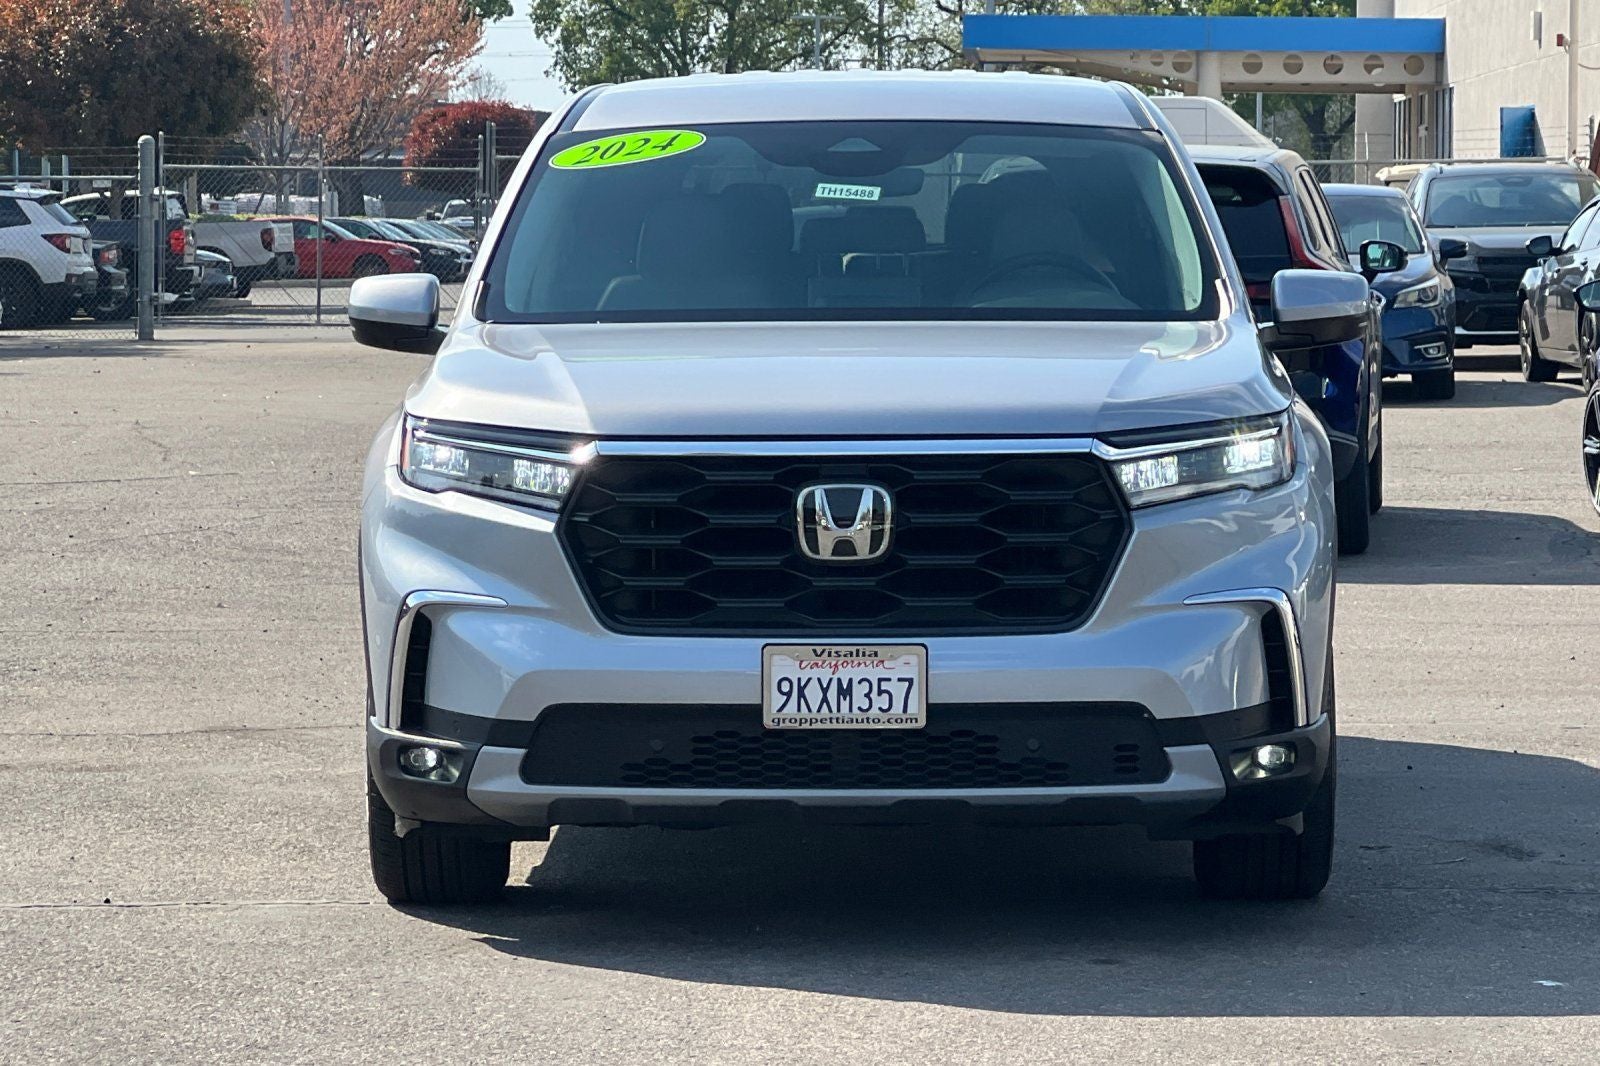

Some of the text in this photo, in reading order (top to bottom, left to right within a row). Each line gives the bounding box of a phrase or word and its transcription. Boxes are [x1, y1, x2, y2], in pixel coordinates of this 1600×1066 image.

[572, 133, 682, 165] 2024
[820, 186, 875, 199] TH15488
[811, 648, 879, 658] Visalia
[798, 659, 896, 675] California
[776, 676, 914, 714] 9KXM357
[771, 715, 919, 726] groppettiauto.com
